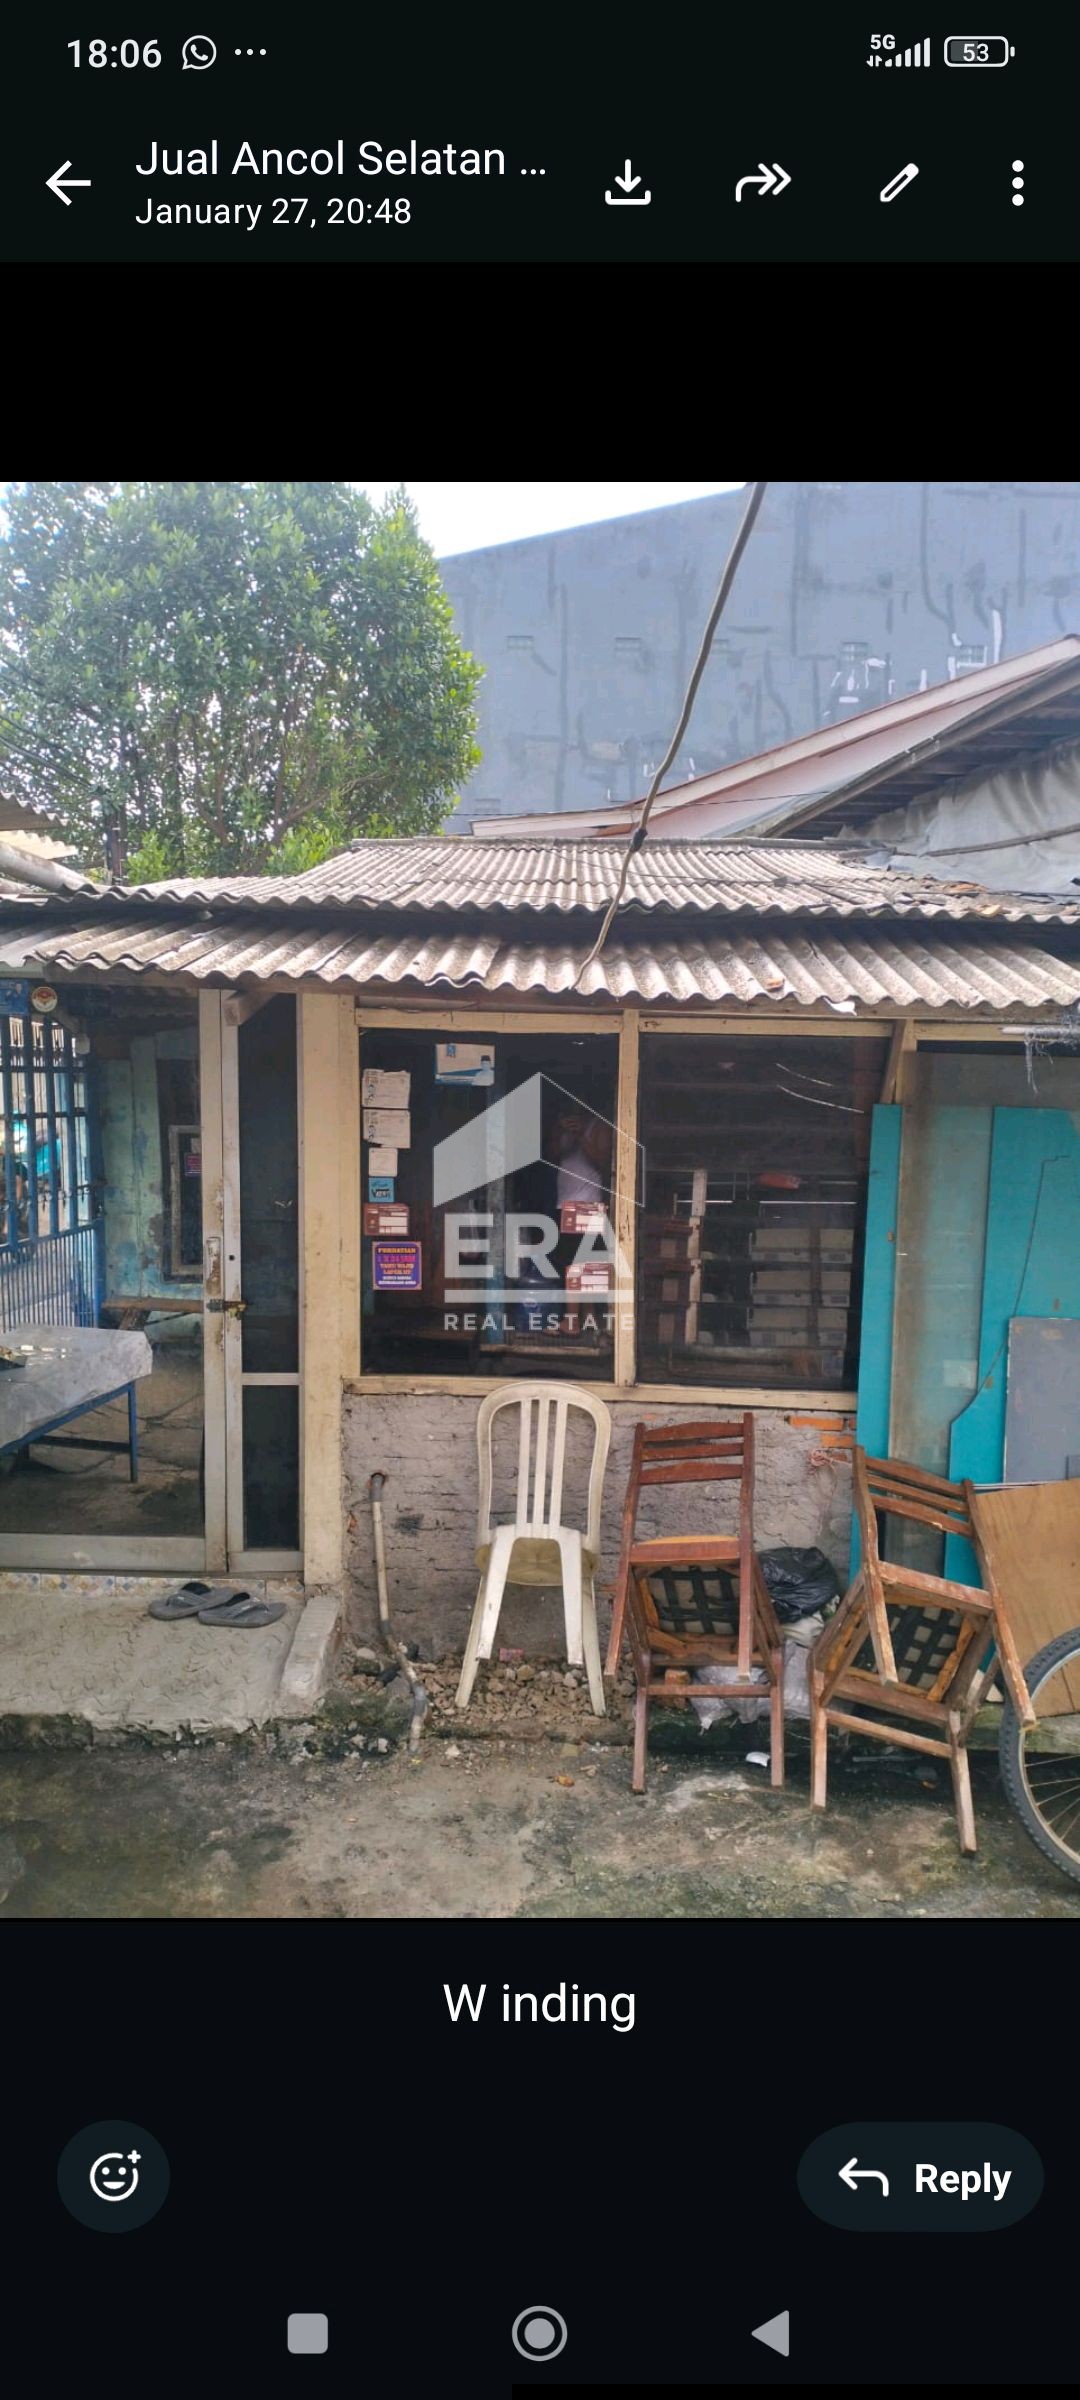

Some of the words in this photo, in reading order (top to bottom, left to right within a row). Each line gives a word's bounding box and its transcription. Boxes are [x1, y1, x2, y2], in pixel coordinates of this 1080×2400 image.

[67, 39, 162, 69] 18:06
[870, 34, 896, 50] 5G
[962, 43, 990, 62] 53
[135, 139, 218, 176] Jual
[231, 139, 344, 176] Ancol
[358, 139, 505, 176] Selatan
[135, 198, 263, 231] January
[271, 198, 316, 229] 27,
[326, 198, 411, 225] 20:48
[443, 1983, 487, 2022] W
[502, 1981, 635, 2033] inding
[915, 2162, 1012, 2201] Reply
